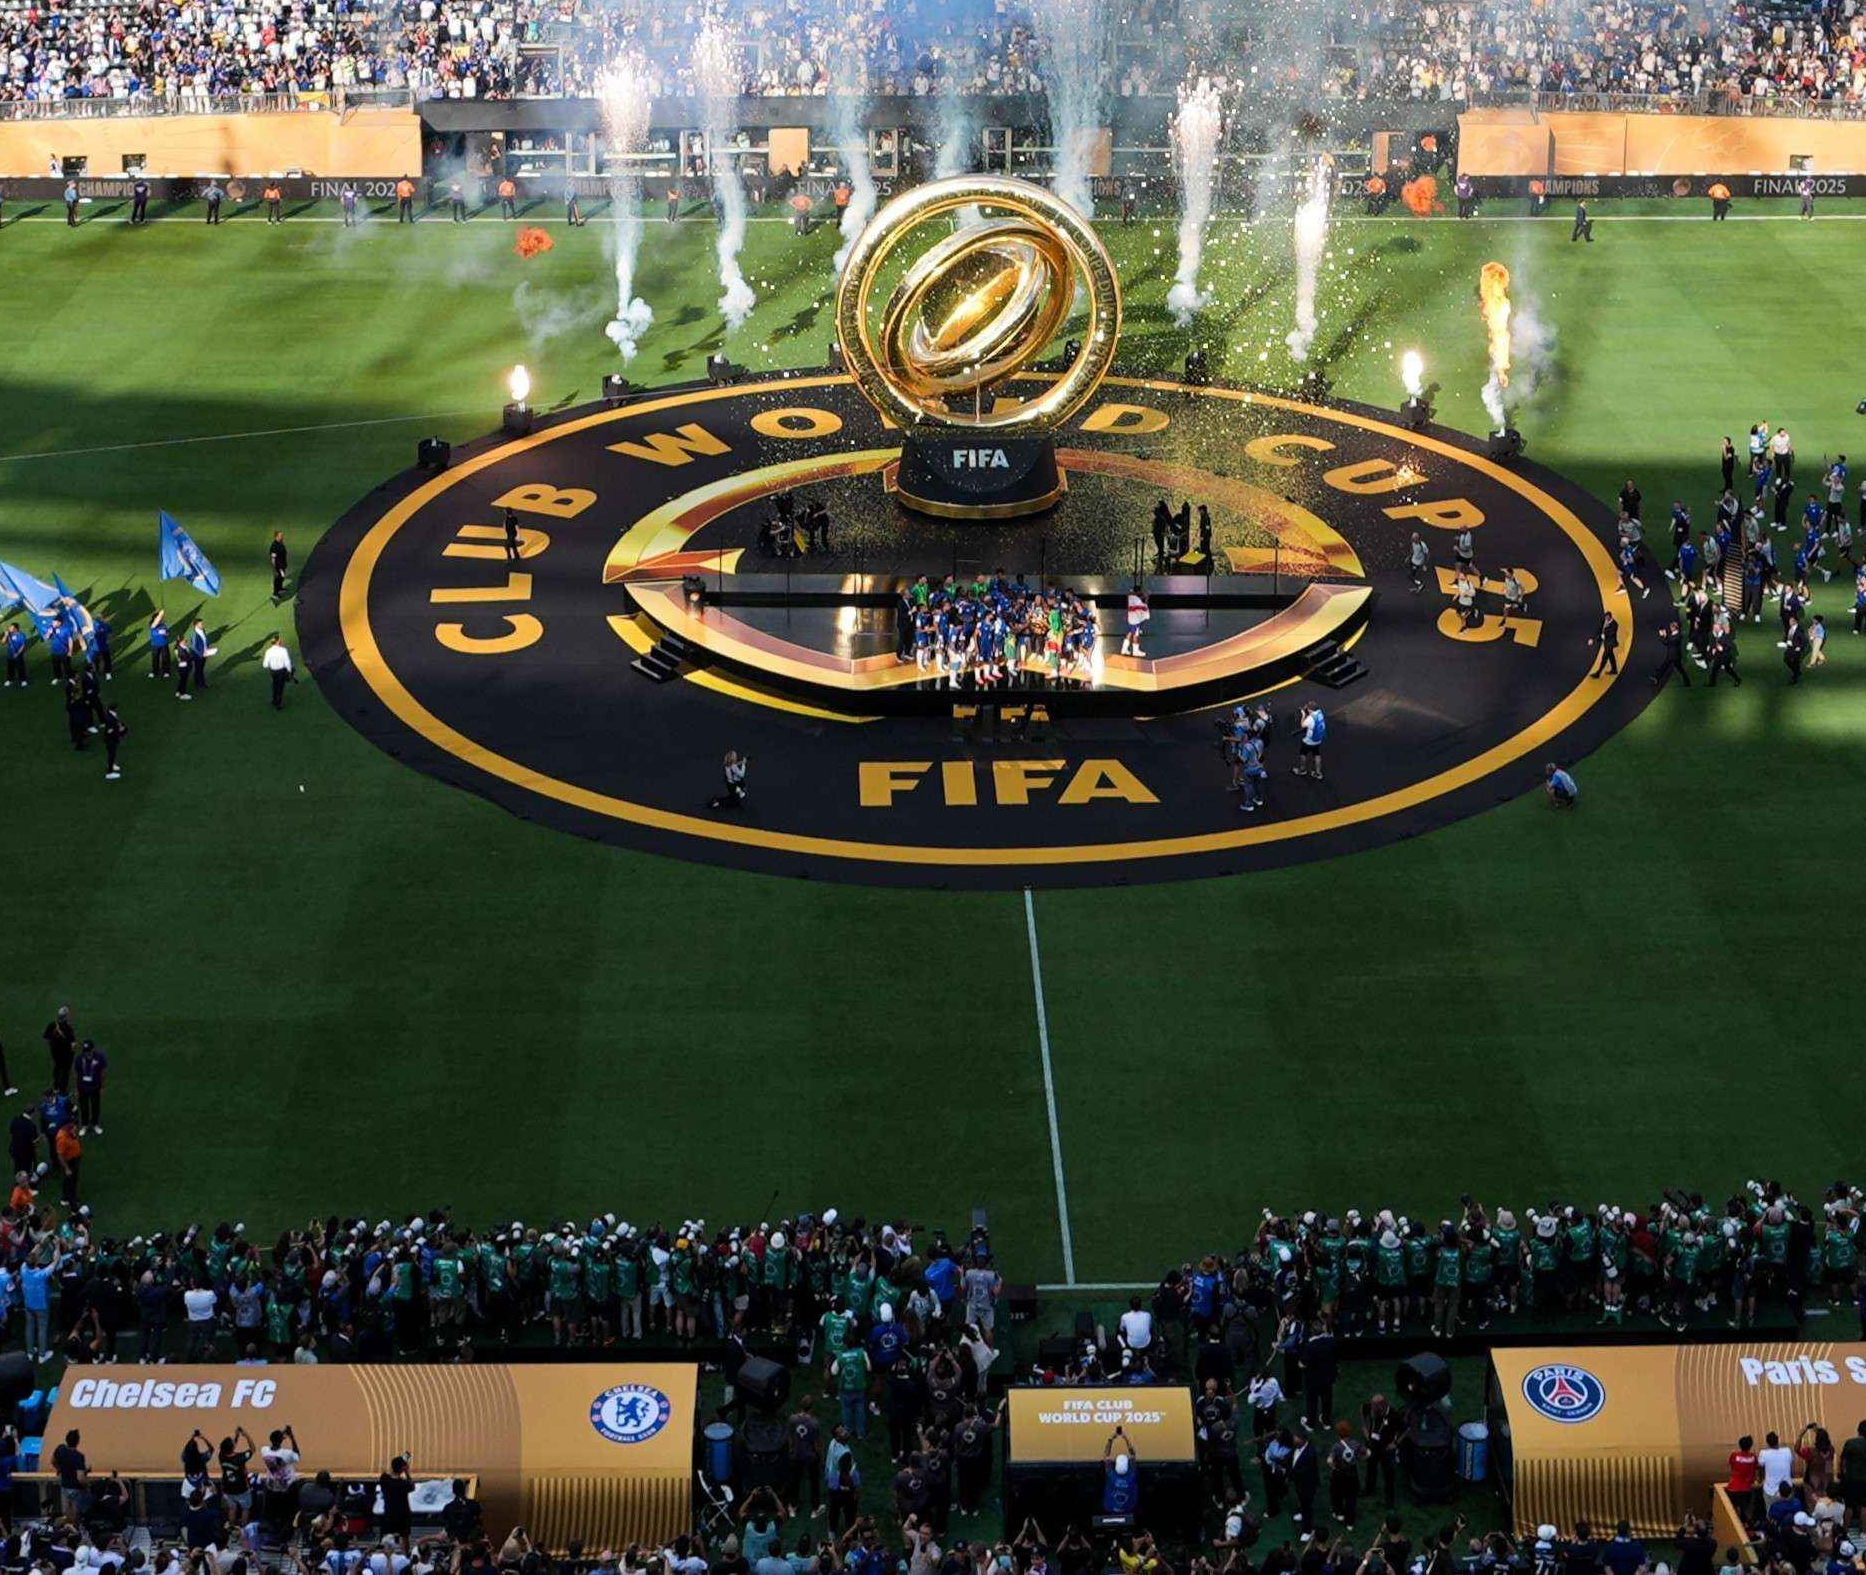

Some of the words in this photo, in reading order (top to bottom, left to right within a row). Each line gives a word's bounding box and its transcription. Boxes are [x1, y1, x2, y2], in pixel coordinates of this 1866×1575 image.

[365, 181, 397, 197] 202
[952, 448, 1010, 469] FIFA
[430, 482, 598, 655] CLUB
[1243, 433, 1485, 530] CUP
[859, 759, 1159, 806] FIFA
[1738, 1353, 1841, 1388] Paris
[69, 1378, 222, 1409] Chelsea
[230, 1378, 277, 1409] FC
[1062, 1399, 1095, 1411] FIFA
[1096, 1399, 1134, 1411] CLUB
[1038, 1412, 1091, 1424] WORLD
[1093, 1412, 1123, 1424] CUP
